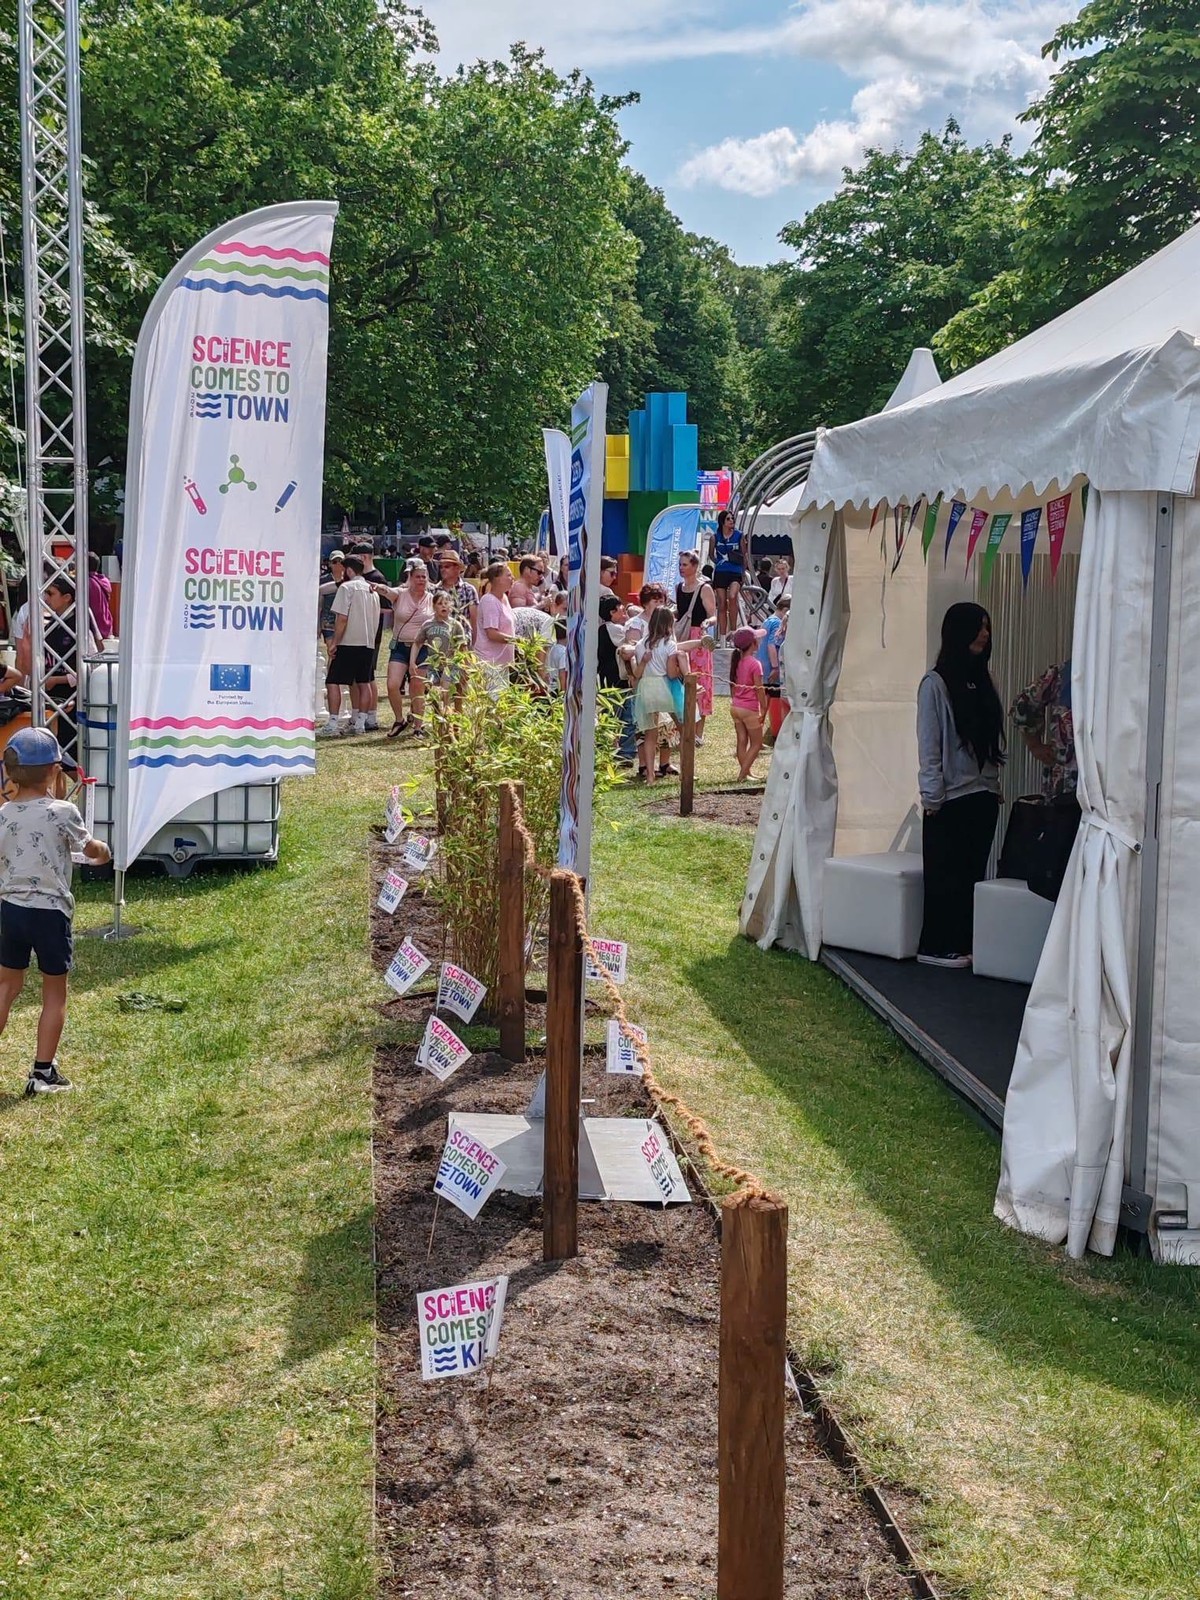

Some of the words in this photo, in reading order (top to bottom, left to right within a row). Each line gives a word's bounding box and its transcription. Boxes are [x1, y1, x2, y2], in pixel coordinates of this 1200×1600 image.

[193, 335, 291, 368] SCIENCE
[191, 365, 261, 392] COMES
[264, 370, 290, 394] TO
[224, 393, 289, 423] TOWN
[185, 547, 285, 577] SCIENCE
[184, 577, 255, 602] COMES
[258, 580, 284, 604] TO
[218, 604, 283, 631] TOWN
[400, 941, 424, 968] CIENCE
[592, 940, 622, 954] CIENCE
[445, 966, 481, 995] SCIENCE
[448, 990, 472, 1010] TOWN
[443, 1145, 478, 1175] COMES
[475, 1168, 490, 1186] TO
[450, 1130, 499, 1175] SCIENCE
[448, 1166, 482, 1200] TOWN
[424, 1285, 496, 1321] SCIENC
[427, 1315, 487, 1347] COMES
